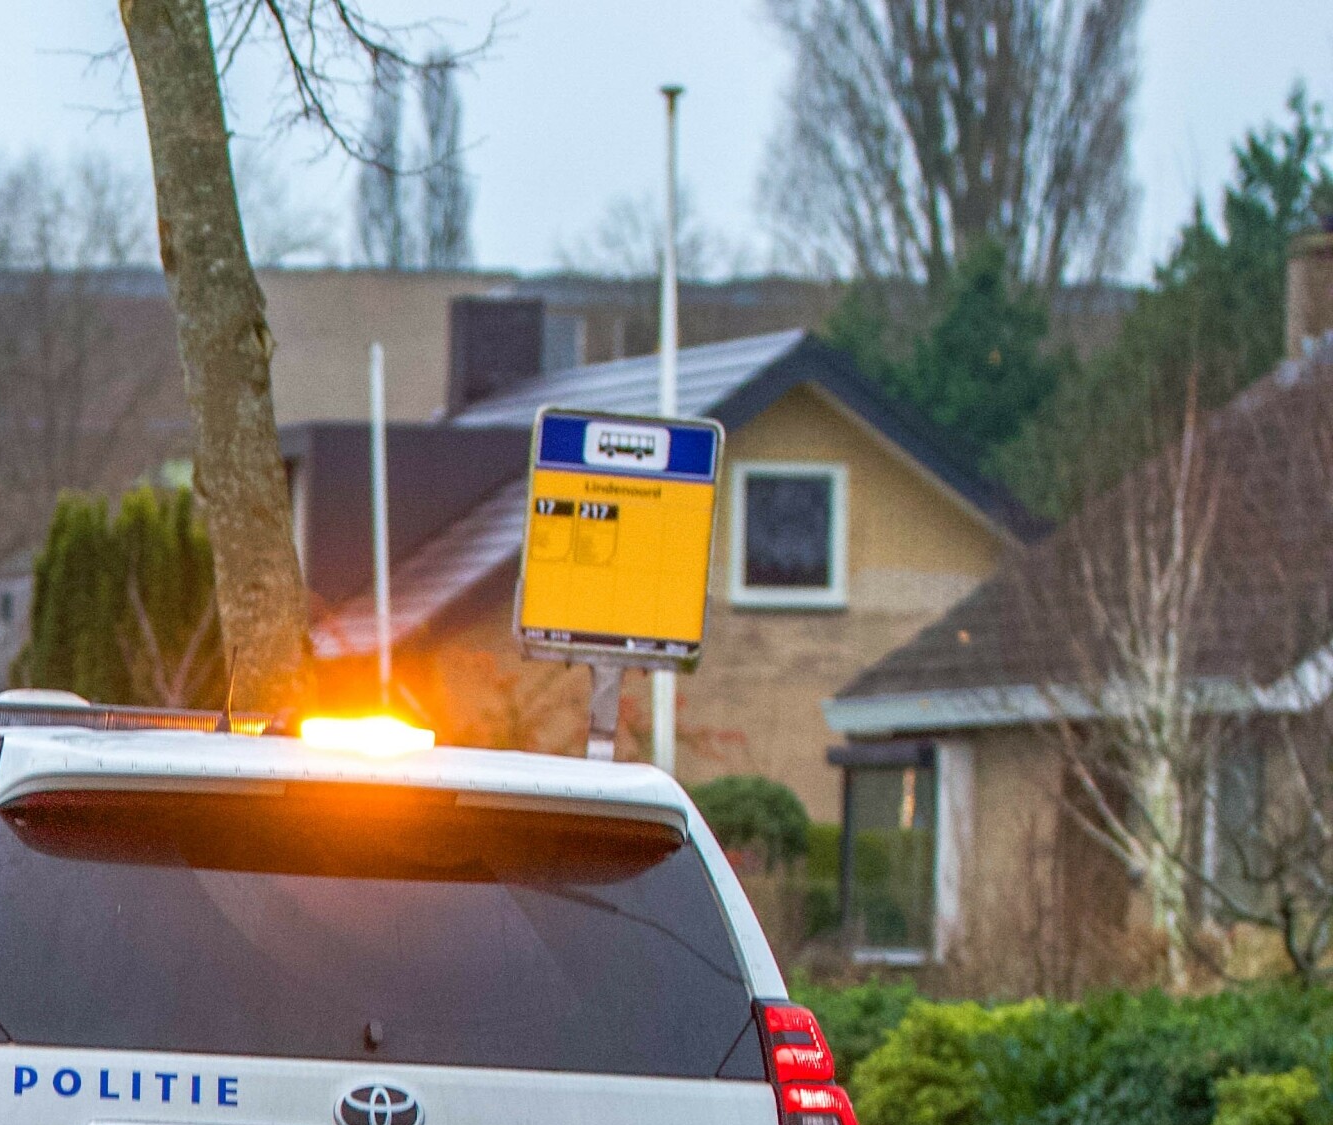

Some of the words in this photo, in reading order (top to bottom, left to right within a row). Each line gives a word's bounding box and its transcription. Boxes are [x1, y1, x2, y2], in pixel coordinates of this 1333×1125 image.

[538, 500, 555, 515] 17
[581, 503, 609, 519] 217
[13, 1065, 239, 1107] POLITIE
